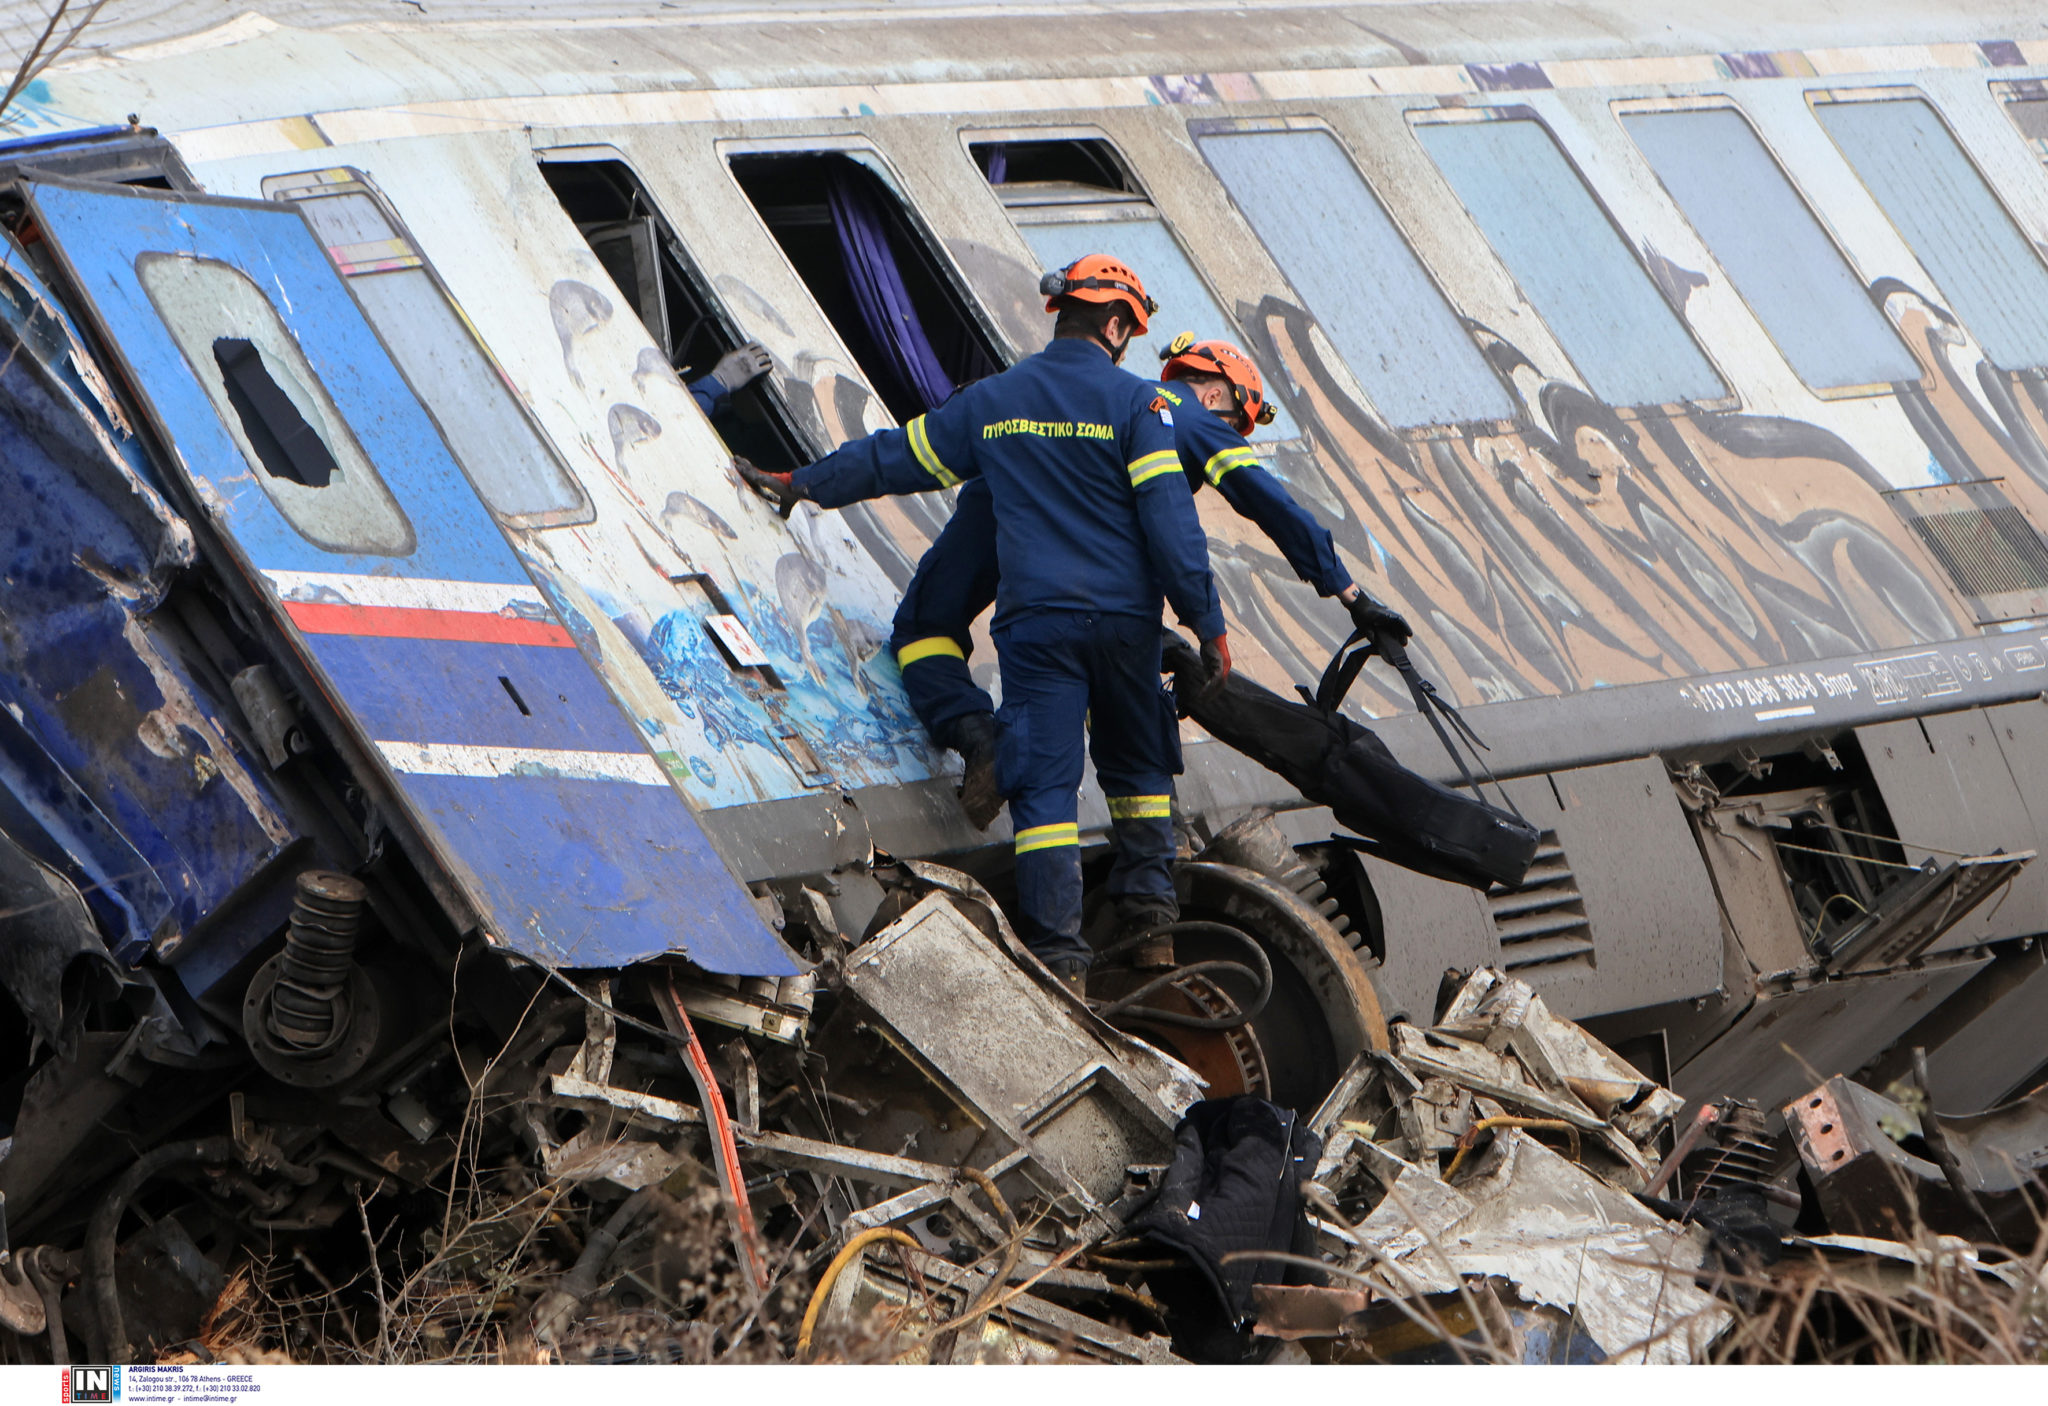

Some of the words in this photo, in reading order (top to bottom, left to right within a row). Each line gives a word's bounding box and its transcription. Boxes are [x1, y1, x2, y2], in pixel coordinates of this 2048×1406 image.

[1155, 386, 1182, 406] ΩΜΑ
[983, 418, 1073, 440] ΠΥΡΟΣΒΕΣΤΙΚΟ
[1076, 422, 1114, 440] ΣΩΜΑ
[1715, 681, 1743, 708] 73
[1737, 677, 1781, 706] 20-96
[1774, 672, 1818, 701] 503-8
[1815, 671, 1858, 700] Bmpz
